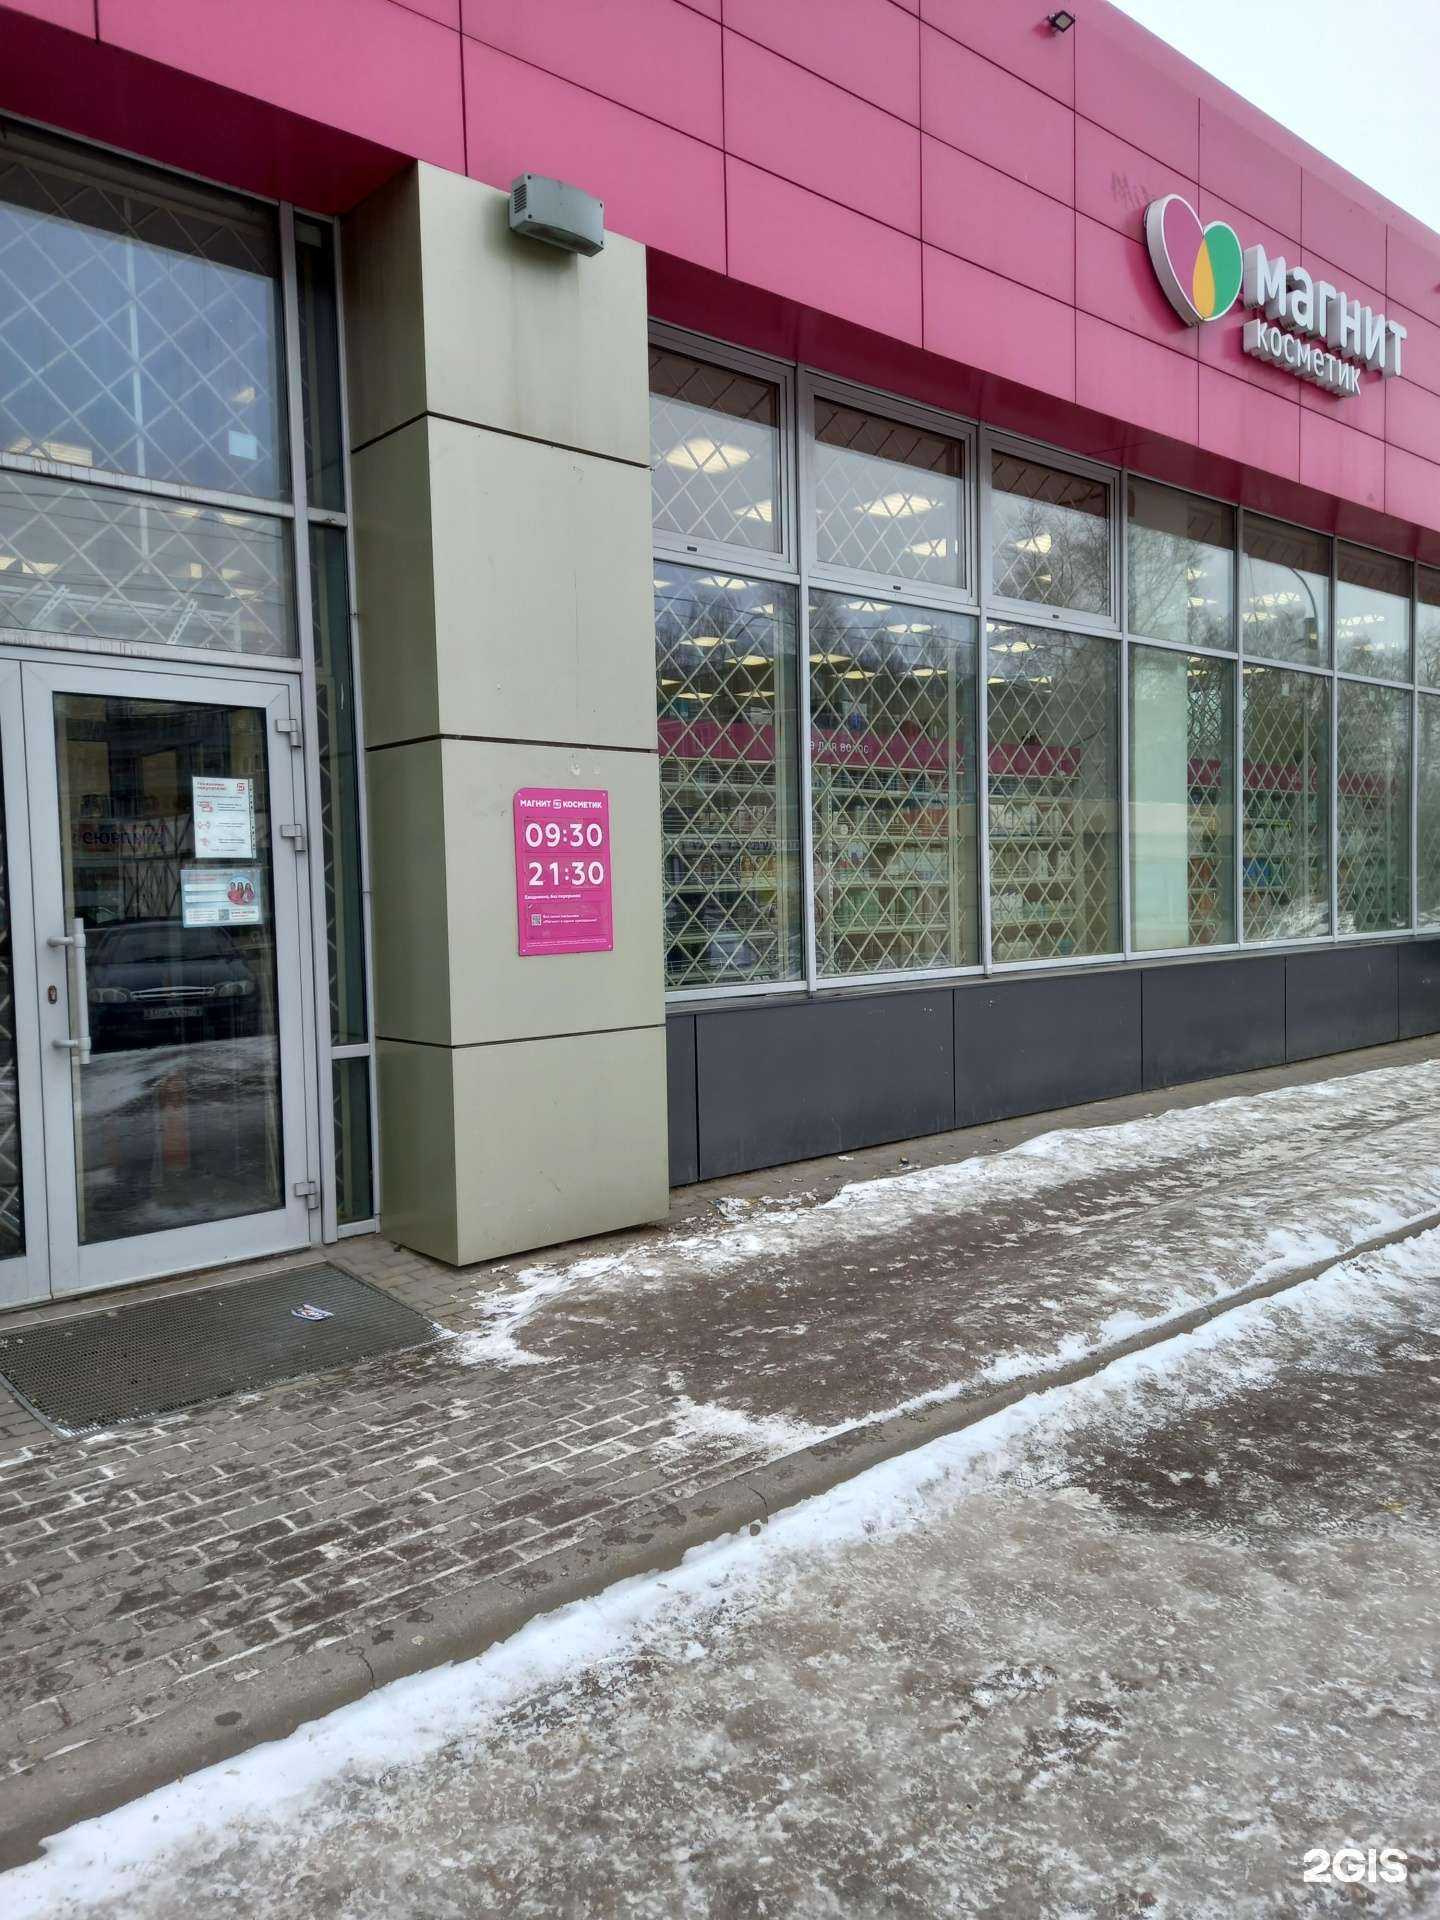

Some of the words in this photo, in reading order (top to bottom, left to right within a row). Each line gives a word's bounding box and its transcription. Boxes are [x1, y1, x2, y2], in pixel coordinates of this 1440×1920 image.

[520, 799, 552, 809] МАГНИТ
[562, 800, 603, 810] КОСМЕТИК
[525, 822, 604, 848] 09:30
[528, 861, 605, 887] 21:30
